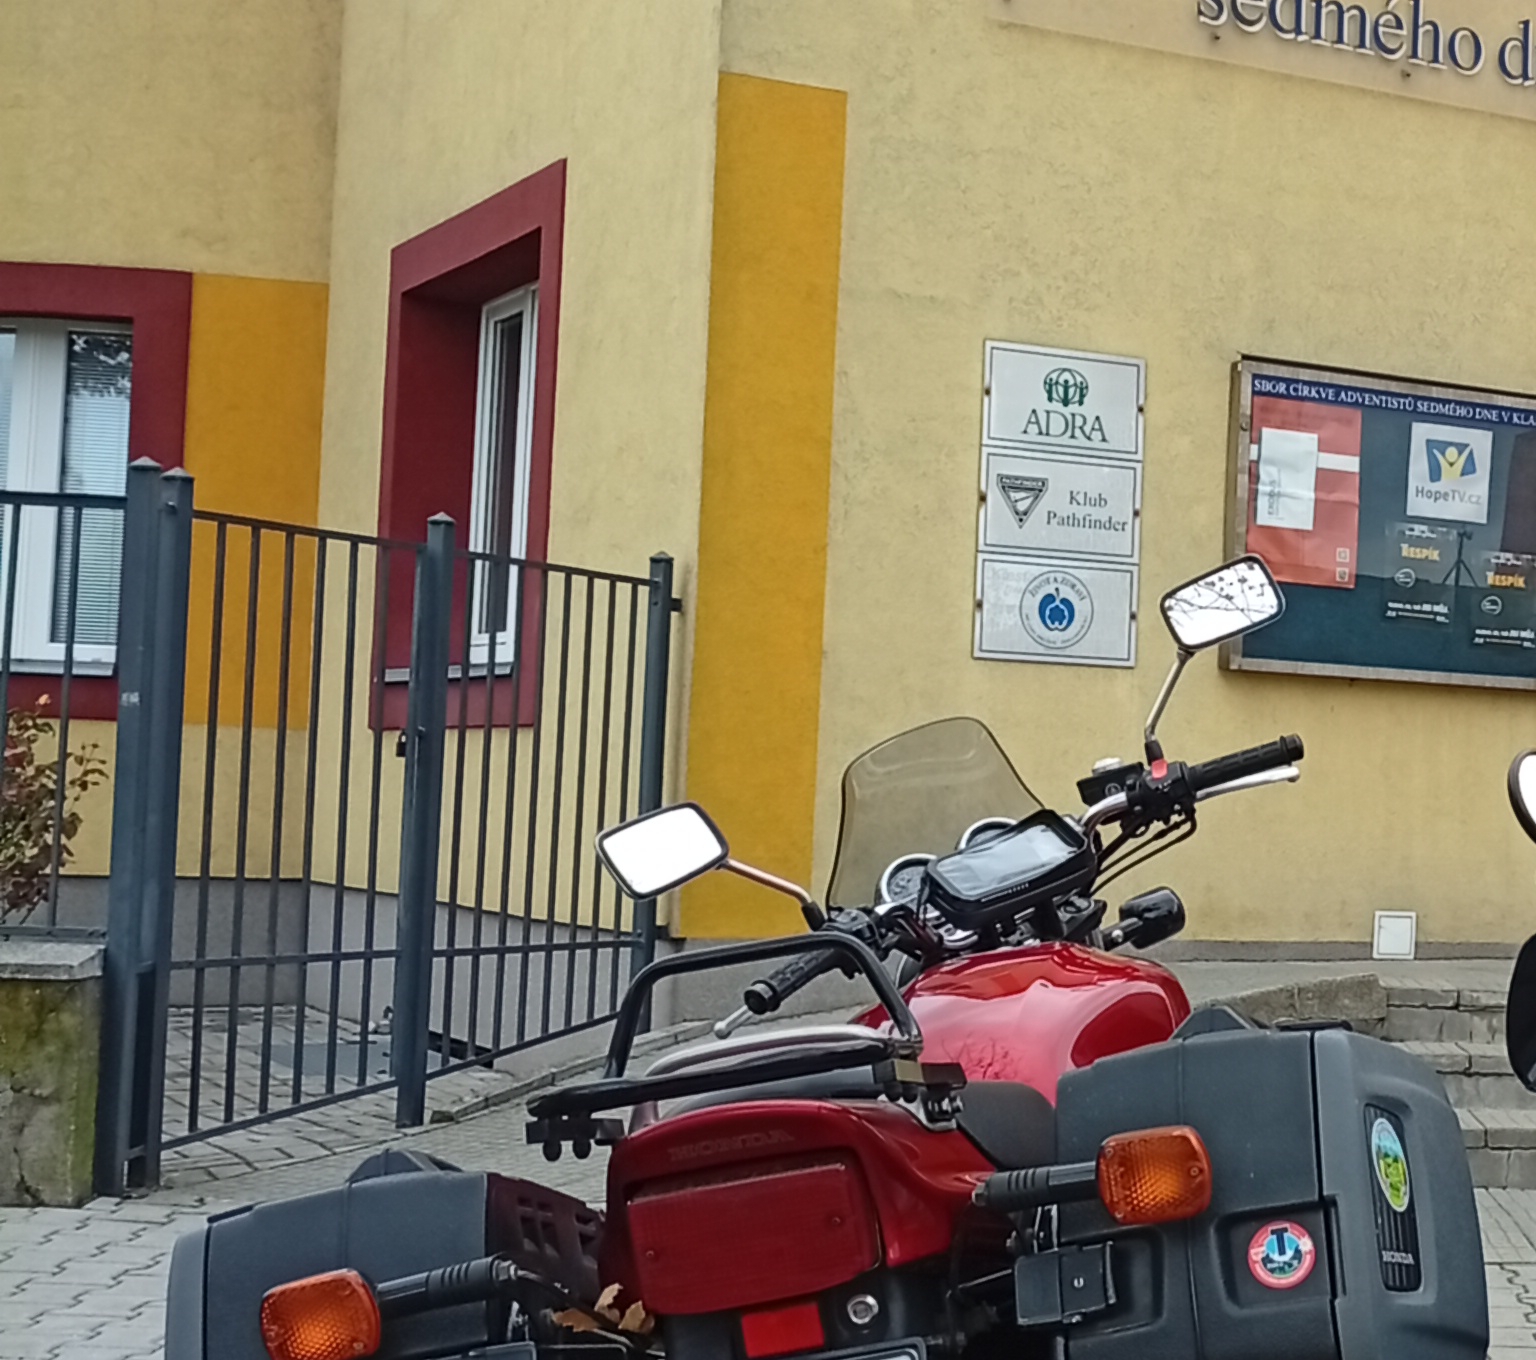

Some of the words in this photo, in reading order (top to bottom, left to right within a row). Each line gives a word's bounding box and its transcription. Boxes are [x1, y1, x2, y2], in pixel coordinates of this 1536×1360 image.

[1254, 379, 1287, 395] SBOR
[1290, 382, 1336, 401] CÍRKVE
[1337, 390, 1414, 411] ADVENTISTŮ
[1416, 400, 1473, 418] SEDMÉHO
[1475, 408, 1499, 422] DNE
[1501, 411, 1511, 423] V
[1021, 408, 1110, 443] ADRA
[1069, 490, 1108, 508] Klub
[1415, 485, 1482, 505] HopeTV.cz
[1046, 510, 1128, 533] Pathfinder
[667, 1129, 796, 1161] HONDA
[1382, 1251, 1415, 1265] HONDA
